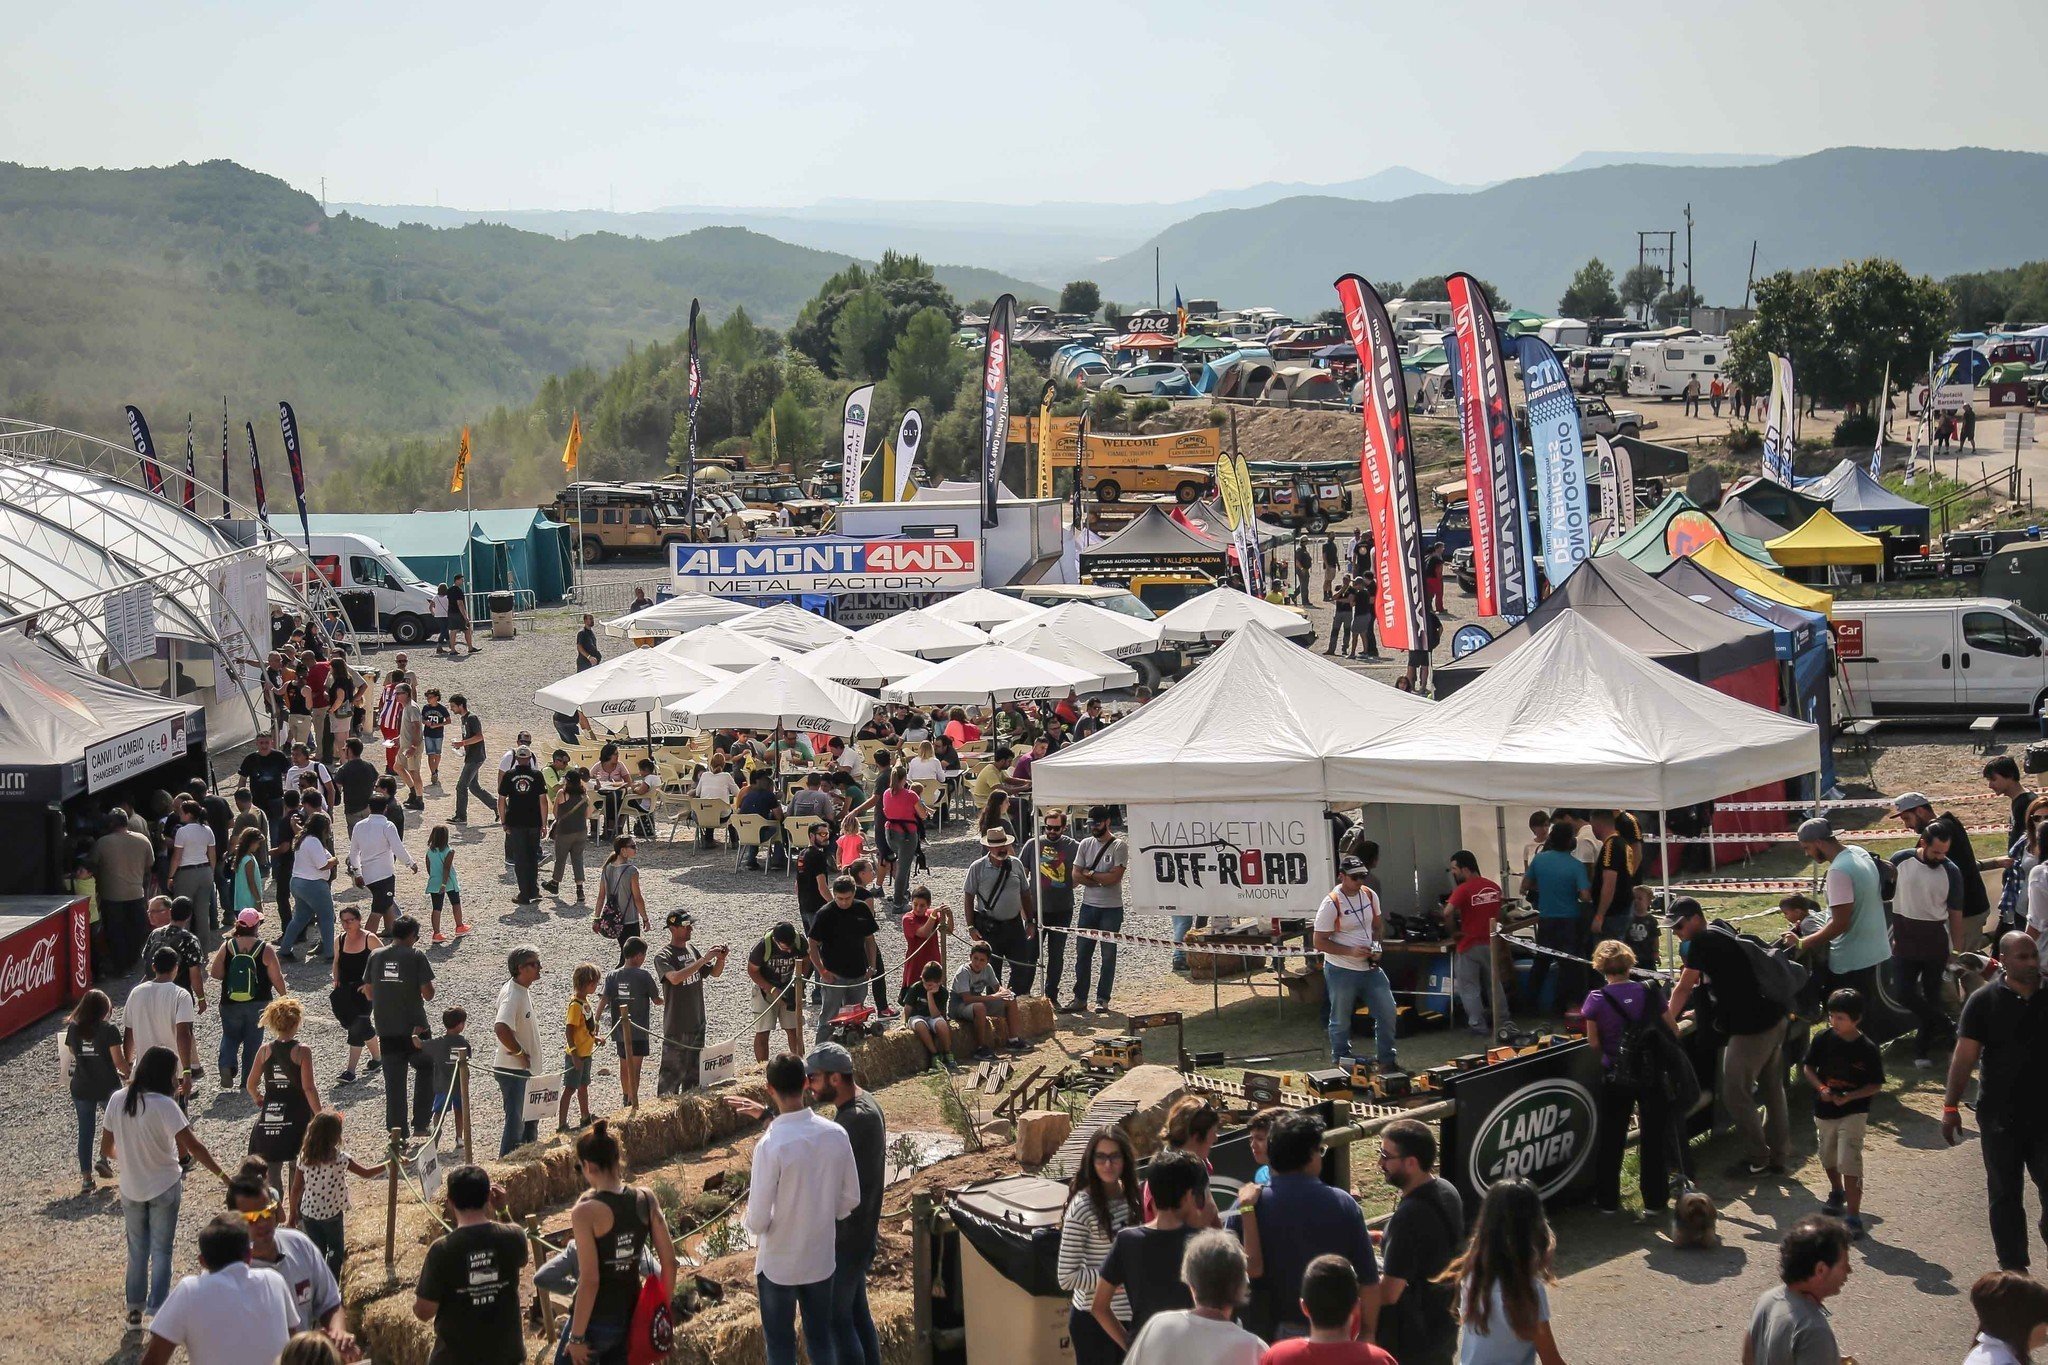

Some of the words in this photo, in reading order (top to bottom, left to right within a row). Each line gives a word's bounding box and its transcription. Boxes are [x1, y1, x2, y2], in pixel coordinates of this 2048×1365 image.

[1127, 317, 1169, 332] GRC
[995, 413, 1006, 443] Heavy
[1102, 439, 1160, 448] WELCOME
[1176, 435, 1206, 445] CAMEL
[679, 545, 865, 574] ALMONT
[1163, 556, 1192, 564] TALLERS
[1192, 556, 1221, 564] VILANOVA
[708, 580, 801, 592] METAL
[813, 576, 942, 590] FACTORY
[840, 613, 855, 621] 4X4
[856, 612, 863, 620] &
[865, 612, 885, 620] 4WD
[1838, 625, 1860, 636] Car
[1013, 686, 1050, 700] Coca-Cola
[601, 699, 637, 714] Coca-Cola
[796, 714, 833, 732] Coca-Cola
[91, 753, 113, 770] CANVI
[117, 737, 144, 759] CAMBIO
[92, 763, 125, 783] CHANGEMENT
[127, 754, 146, 770] CHANGE
[0, 772, 25, 789] urn
[1150, 821, 1305, 846] MARKETING
[1154, 849, 1309, 890] OFF-ROAD
[1245, 888, 1290, 900] MOORLY
[74, 911, 87, 988] Coca-Cola
[0, 932, 59, 1006] Coca-Cola
[704, 1054, 734, 1071] OFF-ROAD
[529, 1090, 559, 1105] OFF-ROAD
[1498, 1104, 1558, 1150] LAND
[1504, 1130, 1575, 1179] ROVER
[470, 1252, 486, 1261] LAND
[470, 1259, 492, 1269] ROVER
